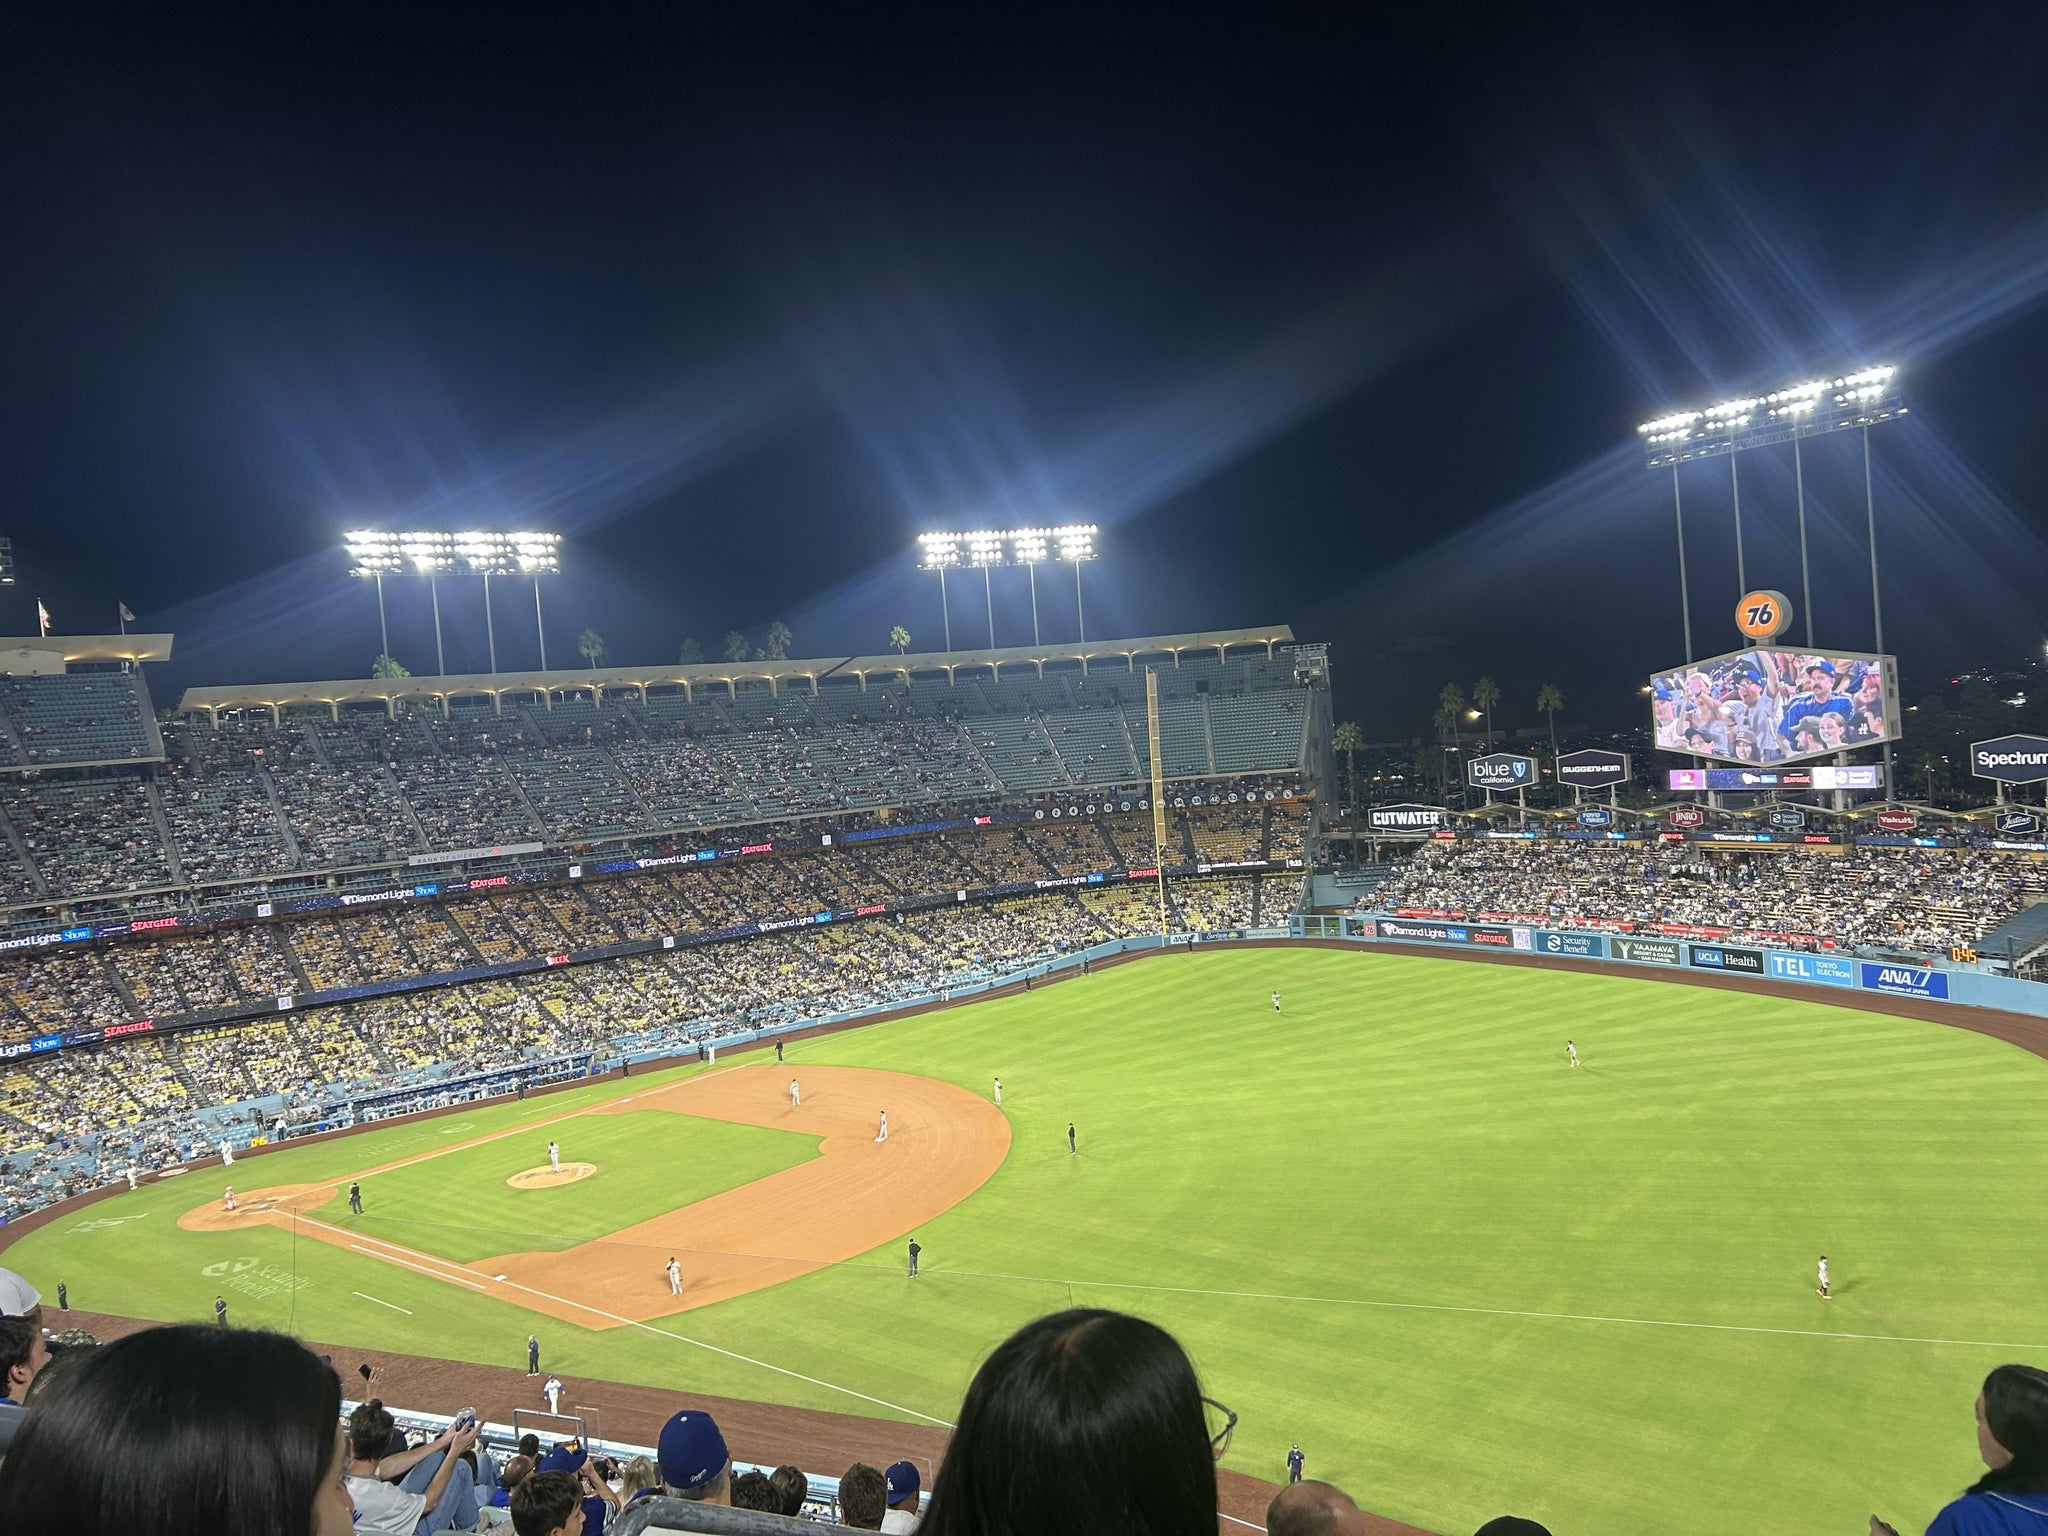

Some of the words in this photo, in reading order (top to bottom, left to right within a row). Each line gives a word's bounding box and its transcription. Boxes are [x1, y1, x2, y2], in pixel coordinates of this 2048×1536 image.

[1745, 602, 1773, 627] 76
[1978, 751, 2048, 768] Spectrum
[1474, 761, 1510, 777] blue
[1562, 765, 1621, 774] GUGGENHEIM
[1480, 776, 1515, 784] california
[1373, 811, 1439, 825] CUTWATER
[1675, 812, 1697, 823] JINRO
[1880, 816, 1914, 824] Yakult
[451, 851, 486, 861] AMERICA
[742, 843, 772, 855] SEATGEEK
[644, 855, 676, 867] Diamond
[677, 853, 697, 864] Lights
[698, 851, 715, 860] Show
[1129, 868, 1159, 878] SEATGEEK
[470, 875, 508, 889] SEATGEEK
[1043, 877, 1068, 887] Diamond
[1068, 875, 1087, 885] Lights
[349, 892, 389, 904] Diamond
[389, 889, 414, 900] Lights
[417, 886, 436, 895] Show
[857, 904, 886, 916] SEATGEEK
[131, 916, 179, 932] SEATGEEK
[766, 919, 794, 930] Diamond
[795, 916, 814, 926] Lights
[31, 932, 62, 947] Lights
[64, 931, 87, 941] Show
[1392, 925, 1423, 938] Diamond
[1424, 927, 1447, 940] Lights
[1447, 929, 1467, 940] Show
[1474, 933, 1508, 944] SEATGEEK
[1562, 936, 1591, 947] Security
[1563, 944, 1588, 954] Benefit
[1952, 947, 1977, 964] 0:45
[1698, 952, 1720, 962] UCLA
[1725, 953, 1758, 968] Health
[1773, 956, 1811, 977] TEL
[1816, 961, 1838, 970] TOKYO
[1817, 968, 1850, 979] ELECTRON
[1878, 969, 1913, 986] ANA
[1878, 983, 1906, 993] Inspiration
[1912, 988, 1930, 996] JAPAN
[104, 1020, 154, 1038] SEATGEEK
[0, 1043, 32, 1057] Lights
[34, 1039, 58, 1050] Show
[690, 1468, 707, 1483] Dodgers
